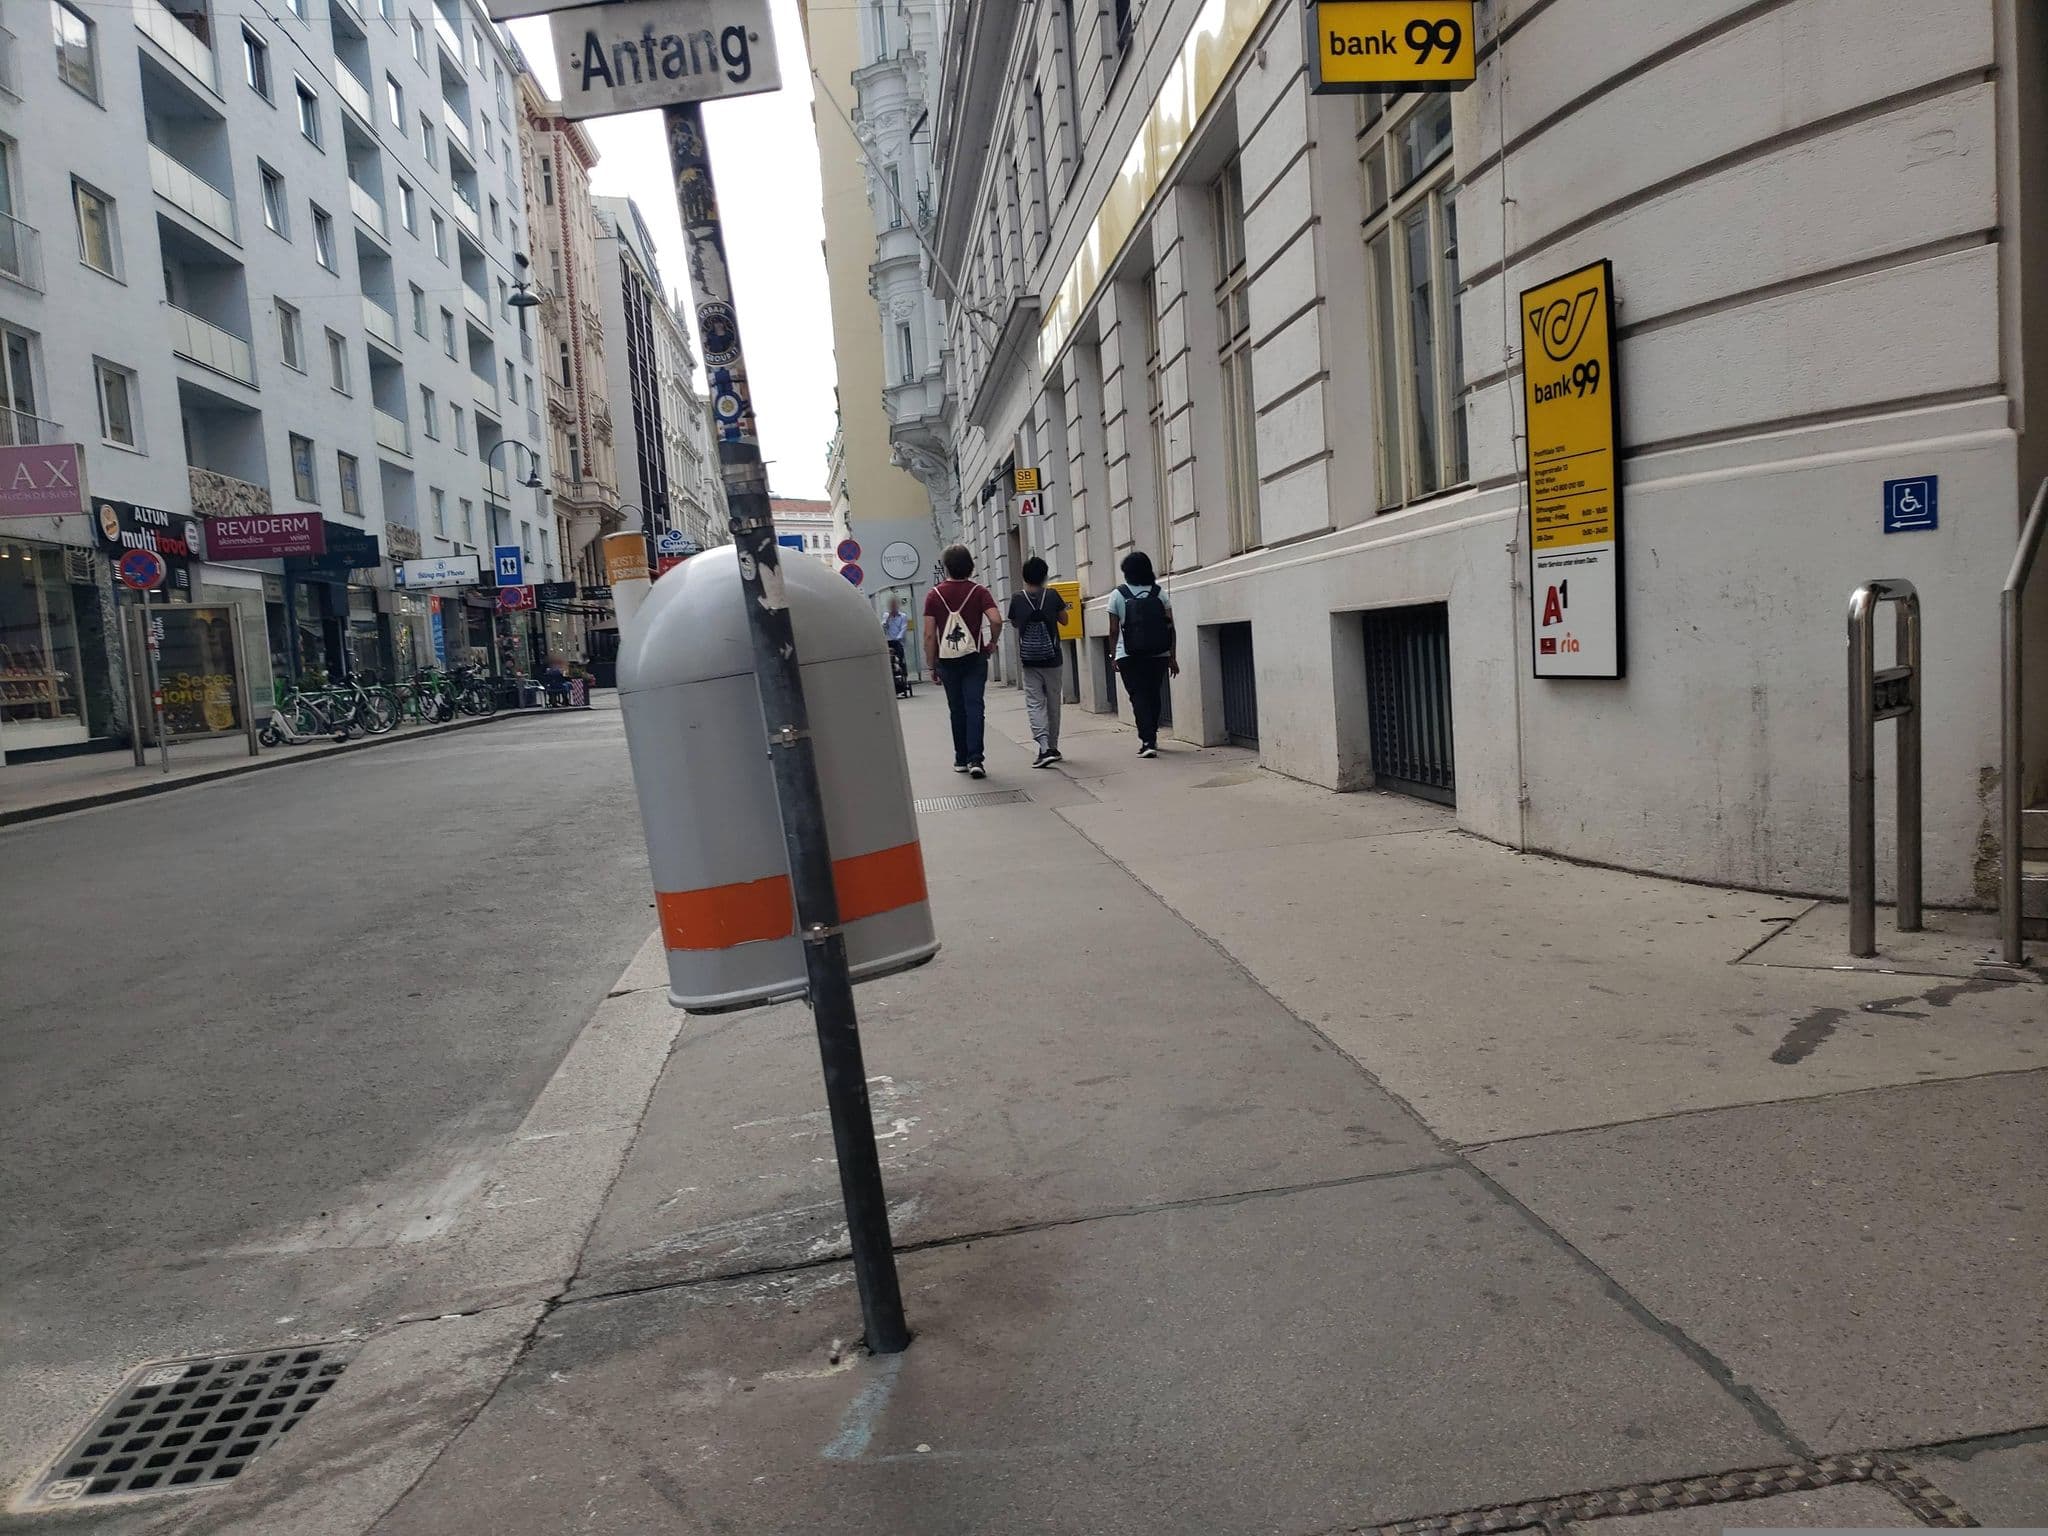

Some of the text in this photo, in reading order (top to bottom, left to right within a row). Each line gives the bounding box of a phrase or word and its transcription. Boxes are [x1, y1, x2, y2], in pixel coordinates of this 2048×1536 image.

[581, 23, 752, 91] Anfang
[1330, 18, 1462, 65] bank 99
[134, 506, 170, 527] ALTUN
[216, 517, 309, 537] REVIDERM
[218, 536, 265, 547] skinmedics
[1542, 579, 1568, 627] A1
